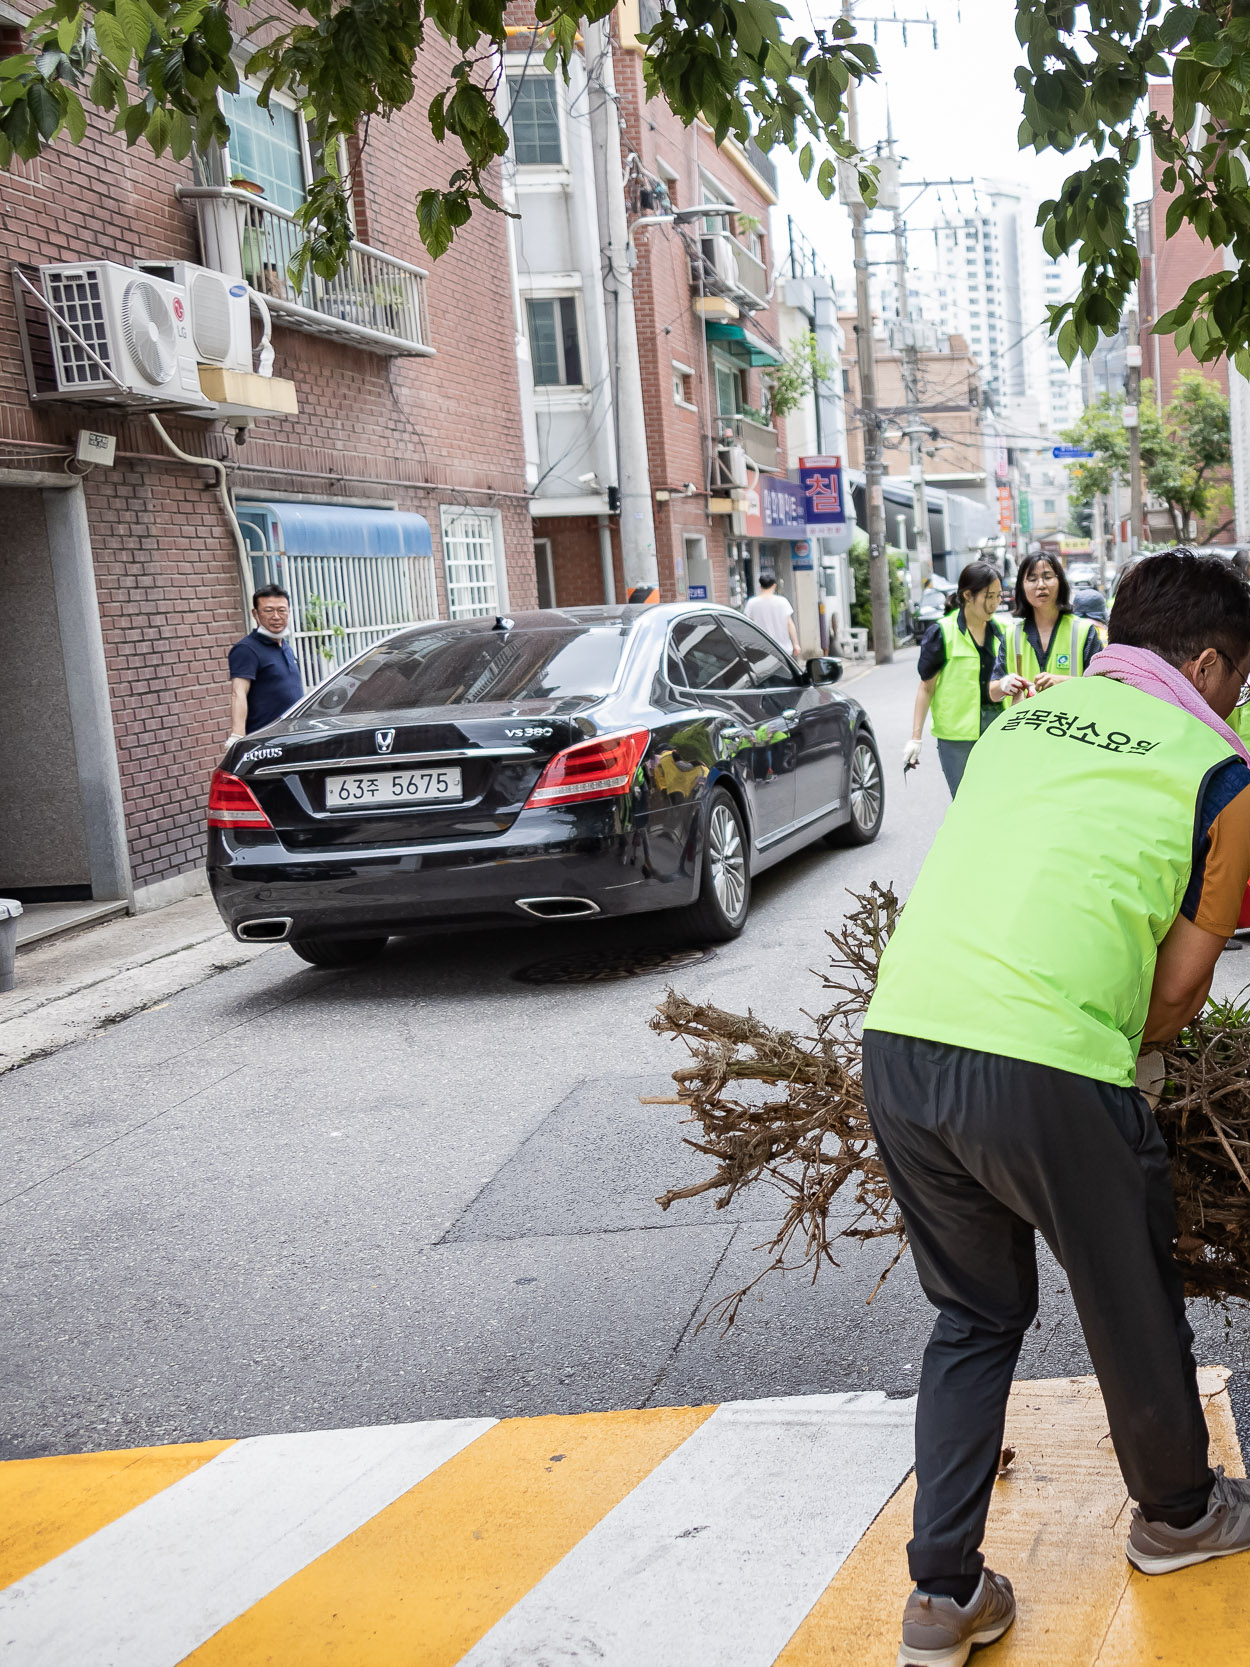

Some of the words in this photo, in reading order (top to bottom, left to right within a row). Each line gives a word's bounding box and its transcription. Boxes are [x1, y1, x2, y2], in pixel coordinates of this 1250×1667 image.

[176, 325, 188, 340] LG
[805, 473, 841, 513] 칠
[1000, 709, 1161, 755] 골목청소요원
[242, 747, 283, 762] EQUUS
[338, 778, 380, 801] 63주
[391, 772, 449, 796] 5675
